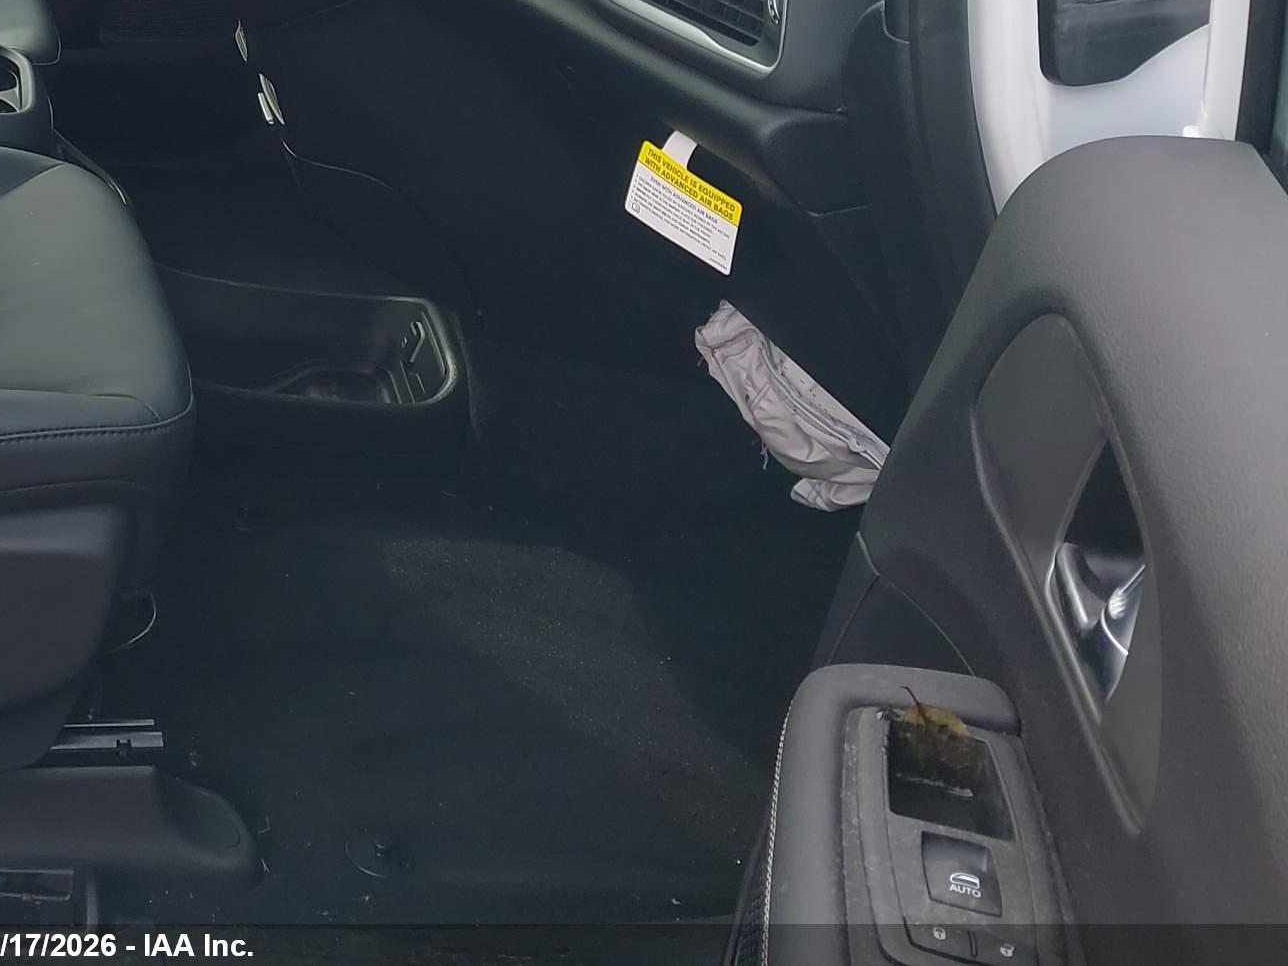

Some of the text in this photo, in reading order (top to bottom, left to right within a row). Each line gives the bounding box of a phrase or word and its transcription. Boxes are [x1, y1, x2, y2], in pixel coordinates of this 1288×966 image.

[644, 157, 661, 173] WITH
[661, 168, 699, 199] ADVANCED
[699, 194, 712, 207] AIR
[647, 148, 736, 212] THIS VEHICLE IS EQUIPPED
[949, 884, 982, 898] AUTO
